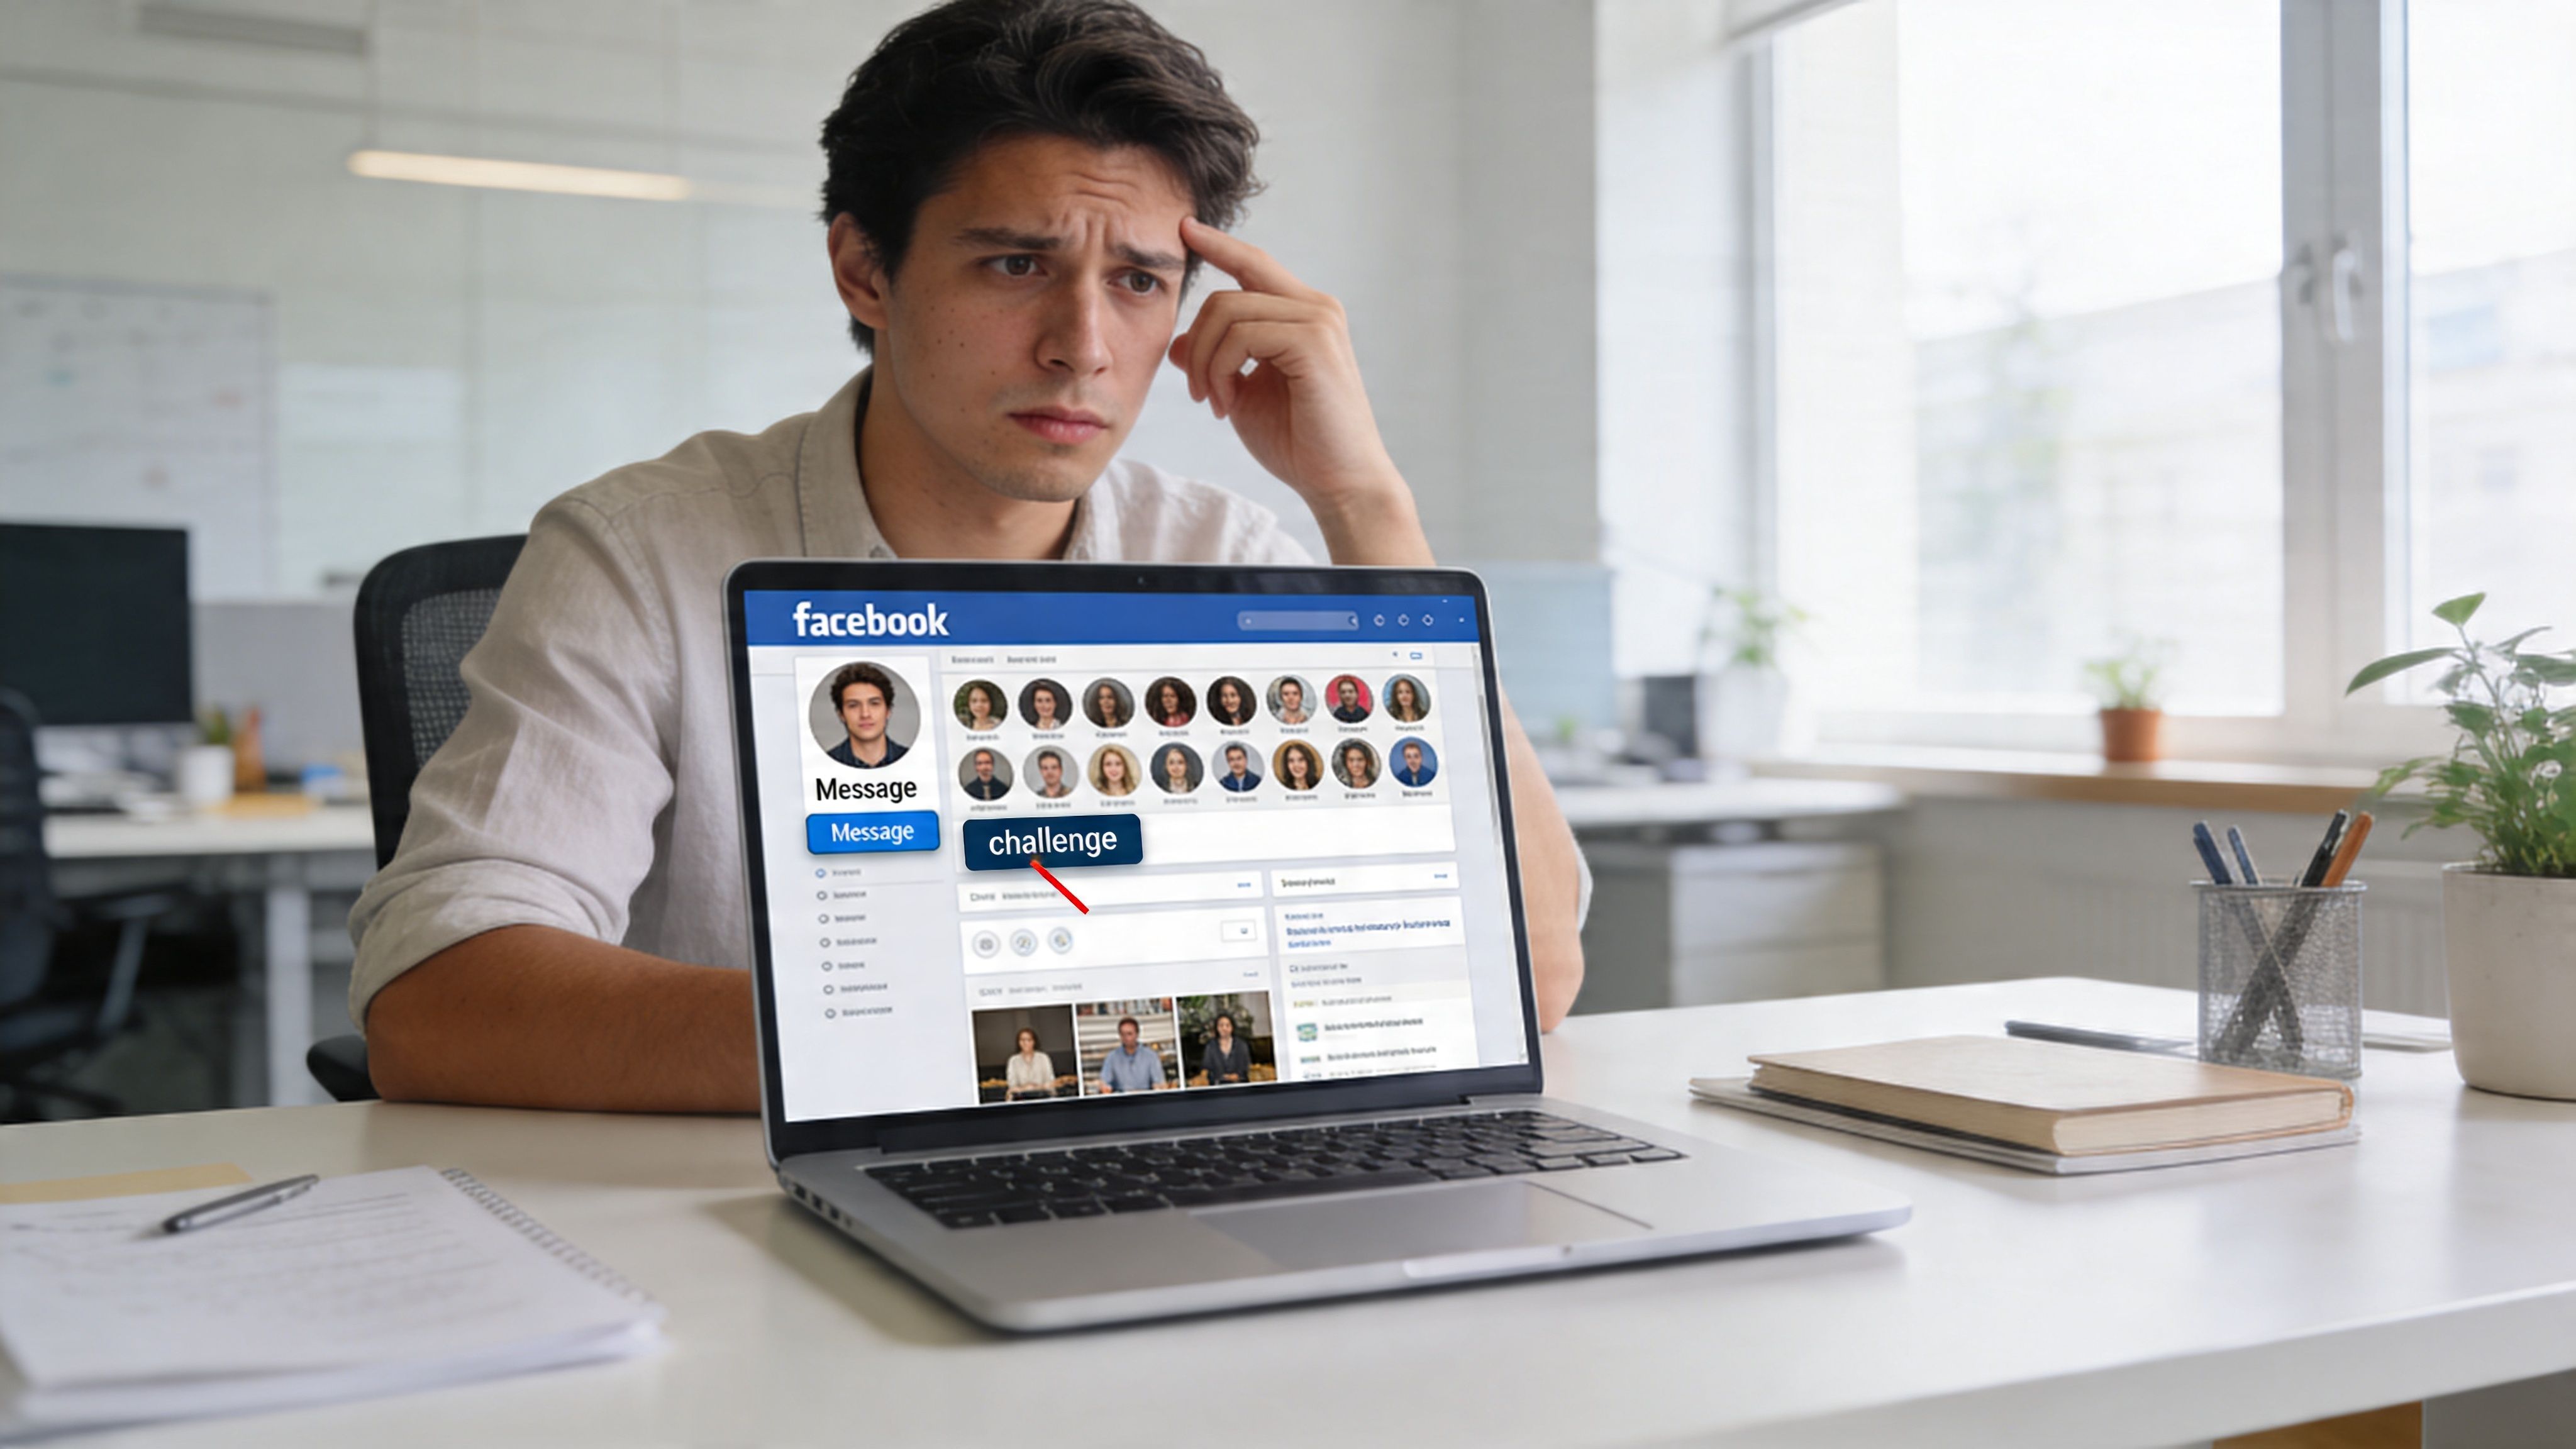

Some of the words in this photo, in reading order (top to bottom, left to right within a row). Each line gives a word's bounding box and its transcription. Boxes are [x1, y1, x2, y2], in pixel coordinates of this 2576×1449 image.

[793, 601, 949, 636] facebook
[816, 778, 917, 804] Message
[831, 823, 914, 845] Message
[989, 826, 1118, 858] challenge
